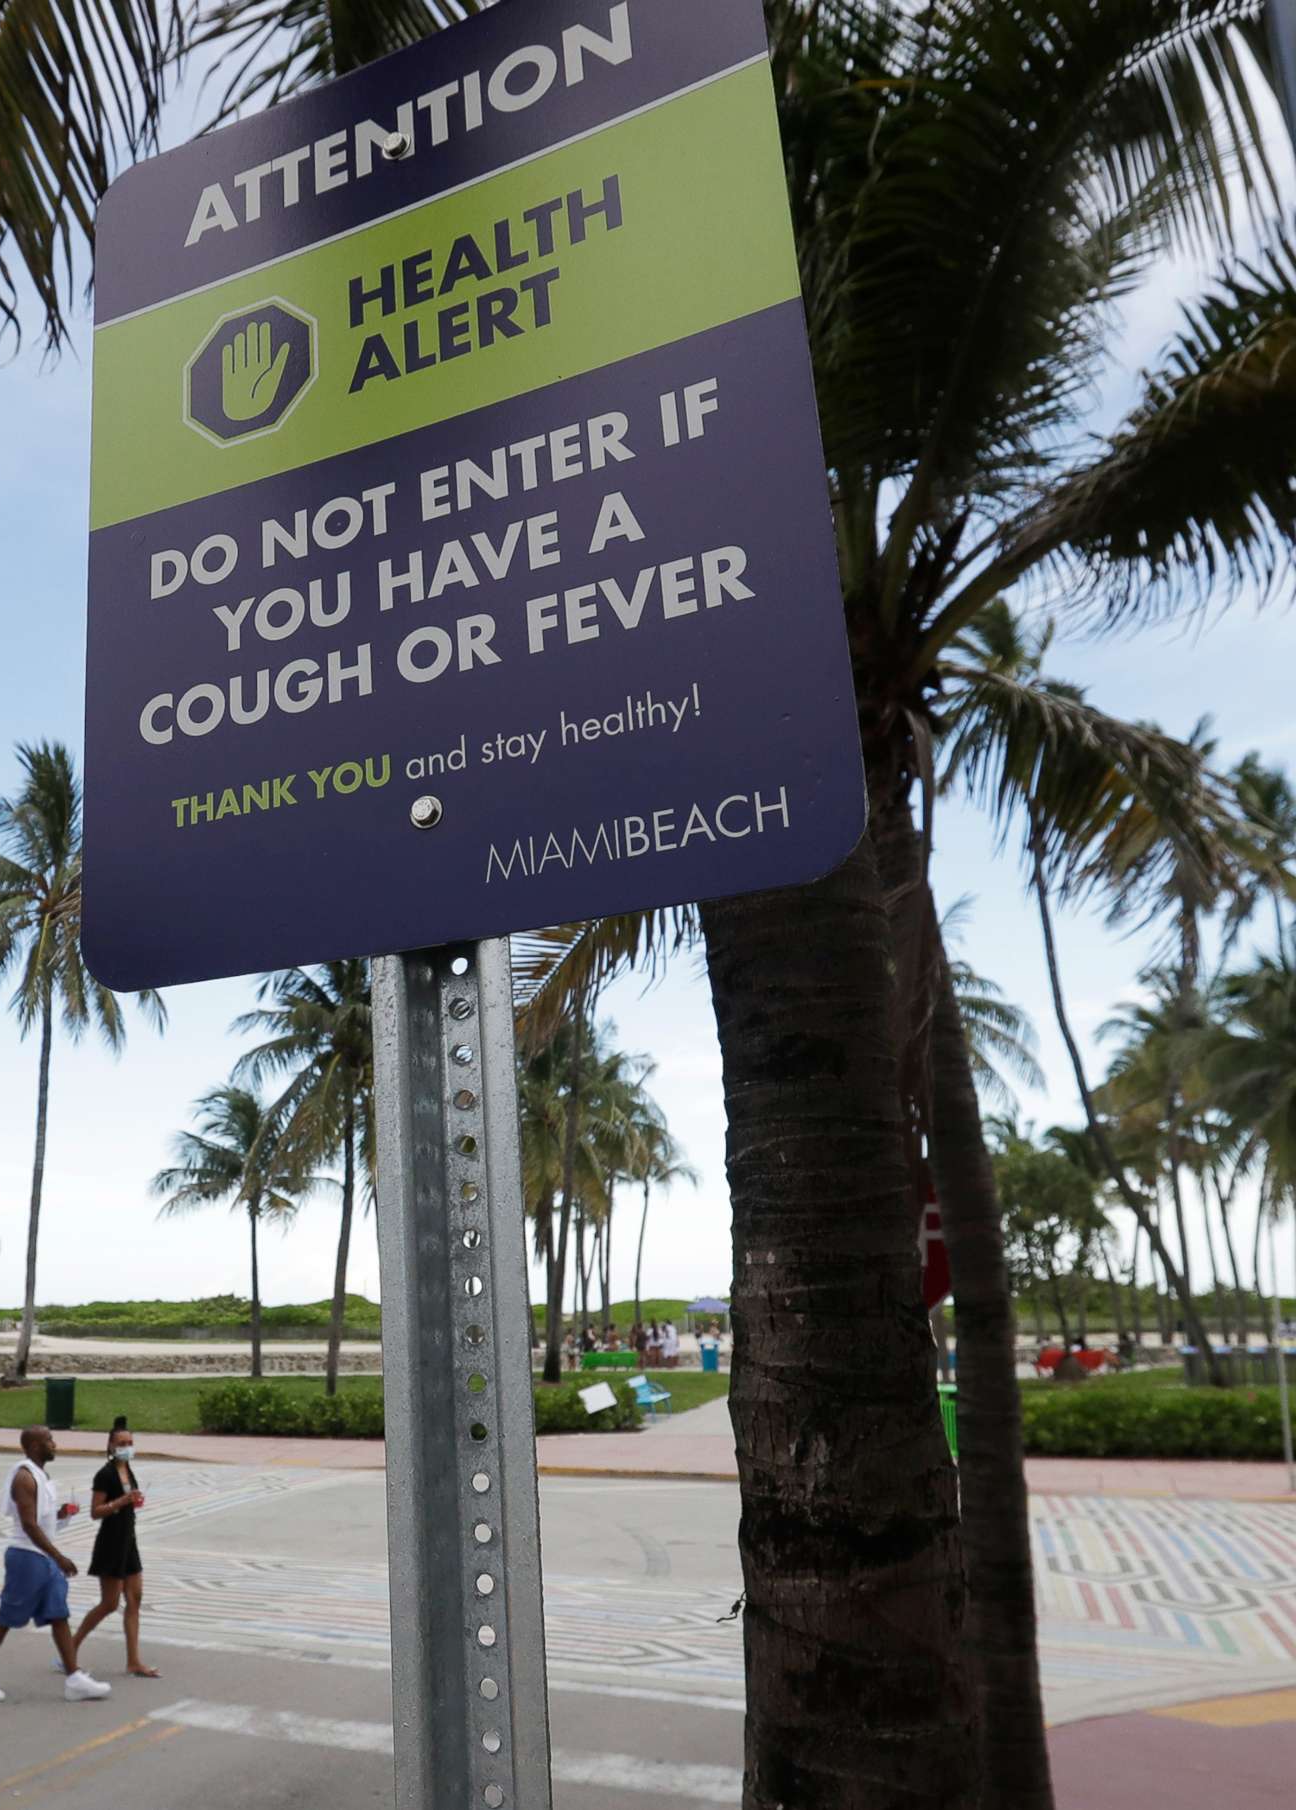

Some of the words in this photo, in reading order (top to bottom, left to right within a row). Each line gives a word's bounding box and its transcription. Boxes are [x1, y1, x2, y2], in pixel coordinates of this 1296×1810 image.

[184, 1, 632, 248] ATTENTION
[348, 268, 560, 393] ALERT
[349, 174, 623, 327] HEALTH
[150, 534, 239, 600] DO
[262, 482, 396, 569] NOT
[421, 411, 637, 522] ENTER
[659, 377, 720, 448] IF
[139, 643, 373, 745] COUGH
[396, 613, 502, 683] OR
[526, 545, 756, 654] FEVER
[213, 571, 352, 652] YOU
[378, 510, 561, 612] HAVE
[588, 492, 646, 554] A
[172, 774, 296, 828] THANK
[307, 754, 392, 800] YOU
[405, 735, 467, 780] and
[481, 729, 547, 765] stay
[560, 683, 702, 746] healthy!
